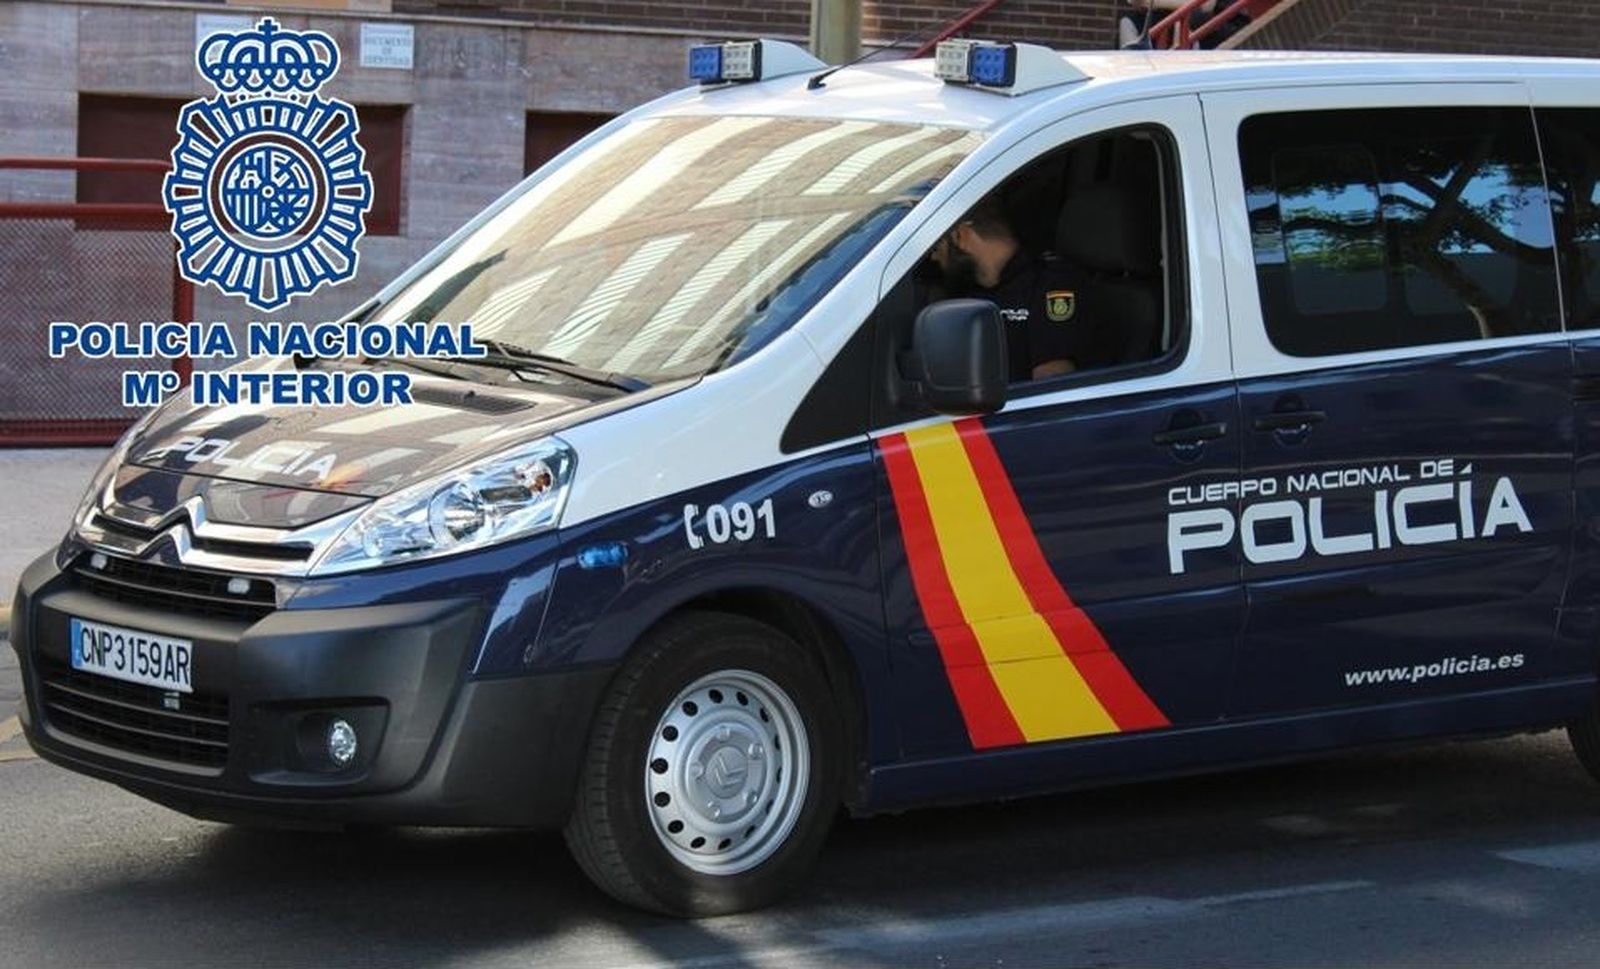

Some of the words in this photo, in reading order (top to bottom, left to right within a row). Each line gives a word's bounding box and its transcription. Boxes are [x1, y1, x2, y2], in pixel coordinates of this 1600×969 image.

[1168, 477, 1277, 505] CUERPO
[1287, 465, 1411, 493] NACIONAL
[1420, 459, 1454, 478] DE
[706, 498, 776, 543] 091
[80, 627, 190, 684] CNP3159AR
[1344, 652, 1525, 686] www.policia.es
